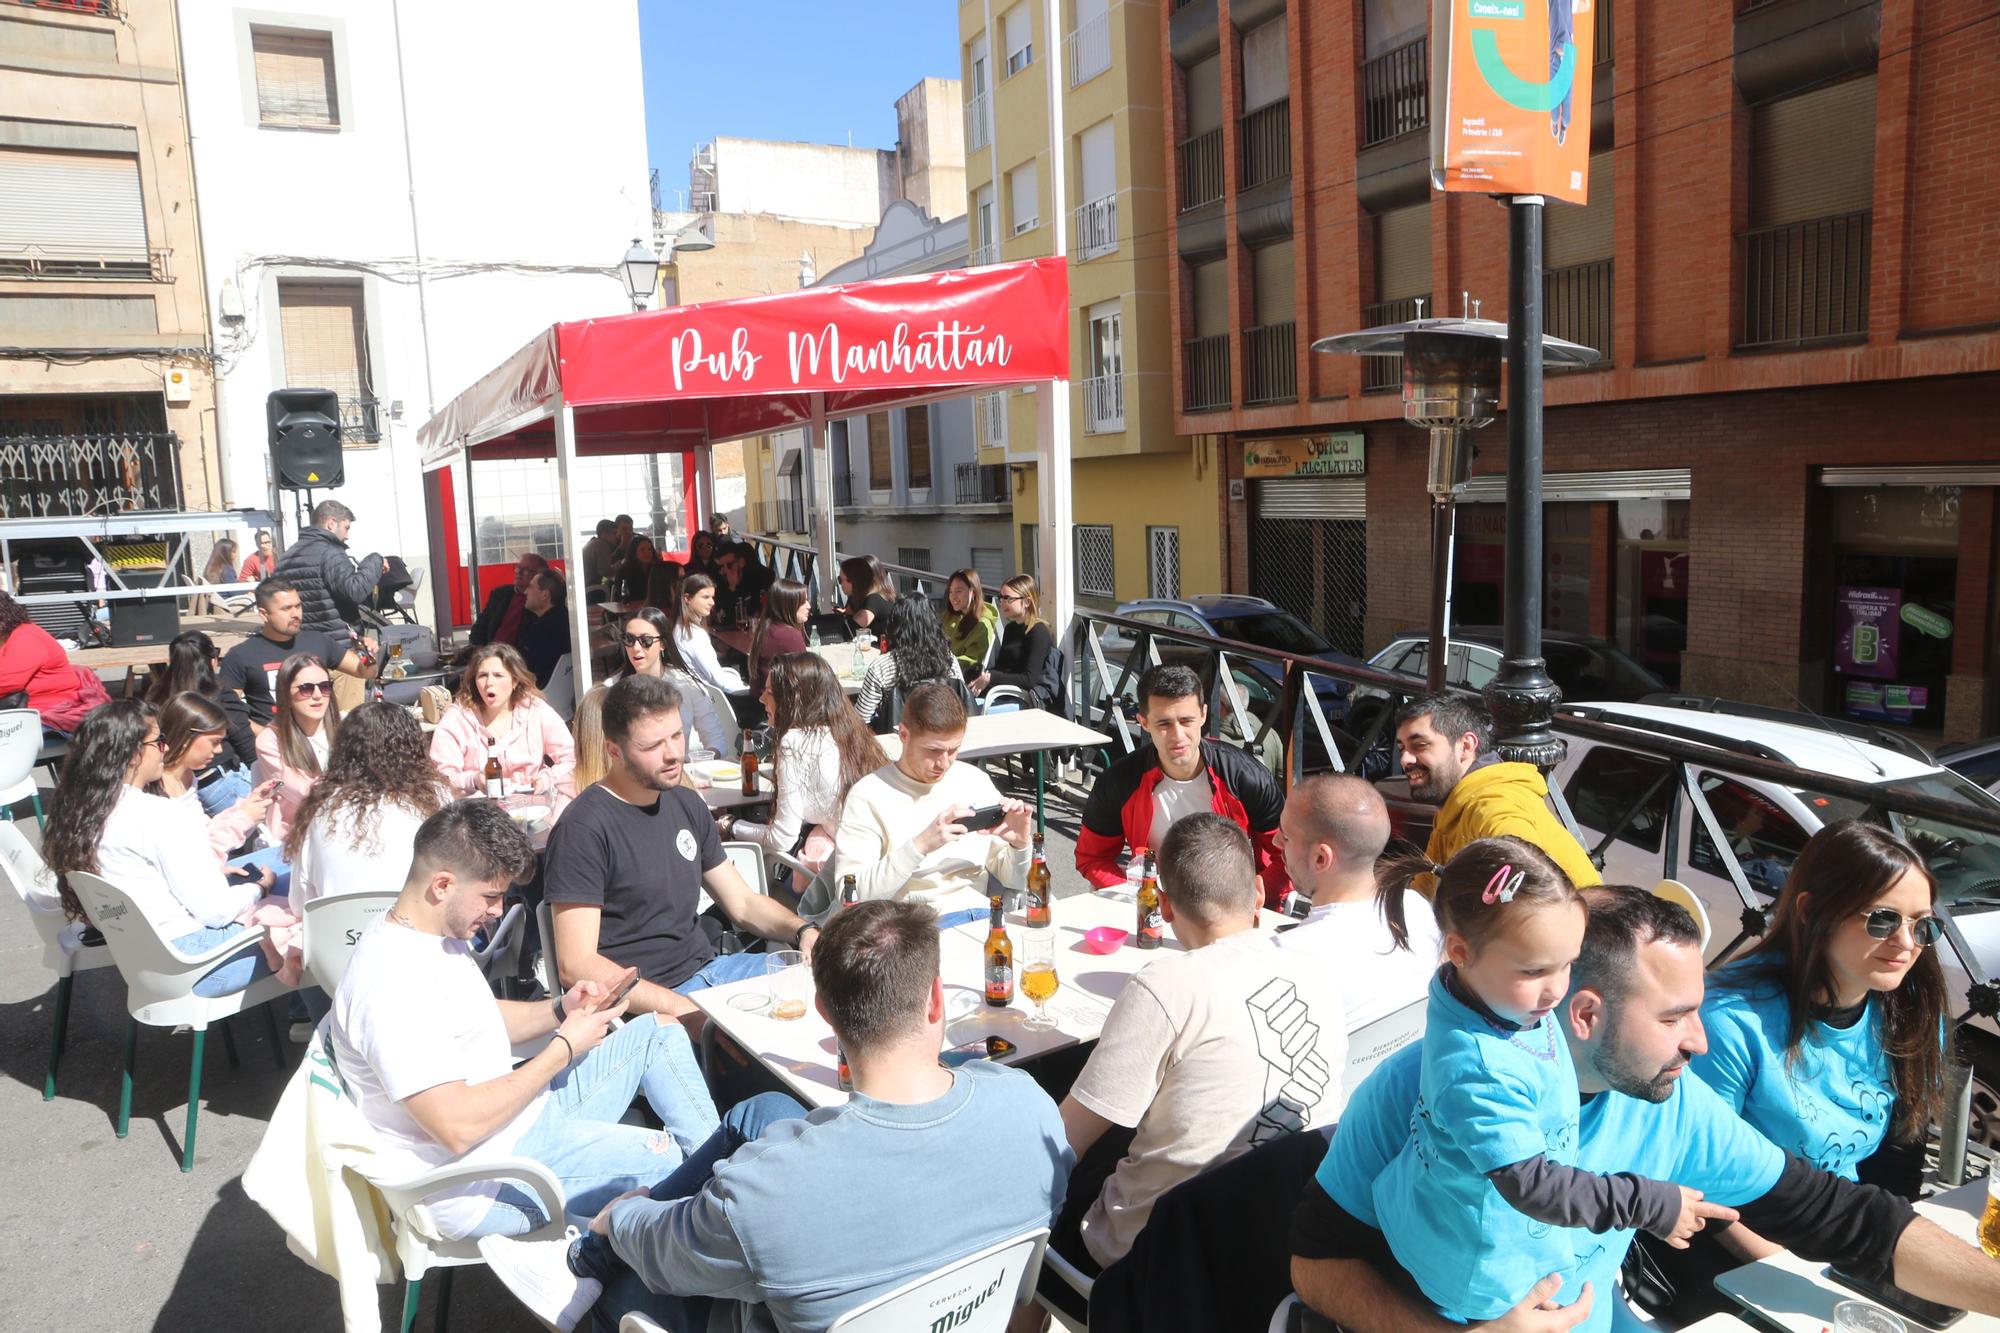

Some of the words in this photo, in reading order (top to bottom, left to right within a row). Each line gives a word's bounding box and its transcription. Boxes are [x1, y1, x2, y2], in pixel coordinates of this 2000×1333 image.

[670, 326, 763, 391] Pub
[787, 319, 1012, 384] Manhattan
[928, 1266, 1006, 1333] Miguel
[929, 1285, 973, 1308] CERVEZAS
